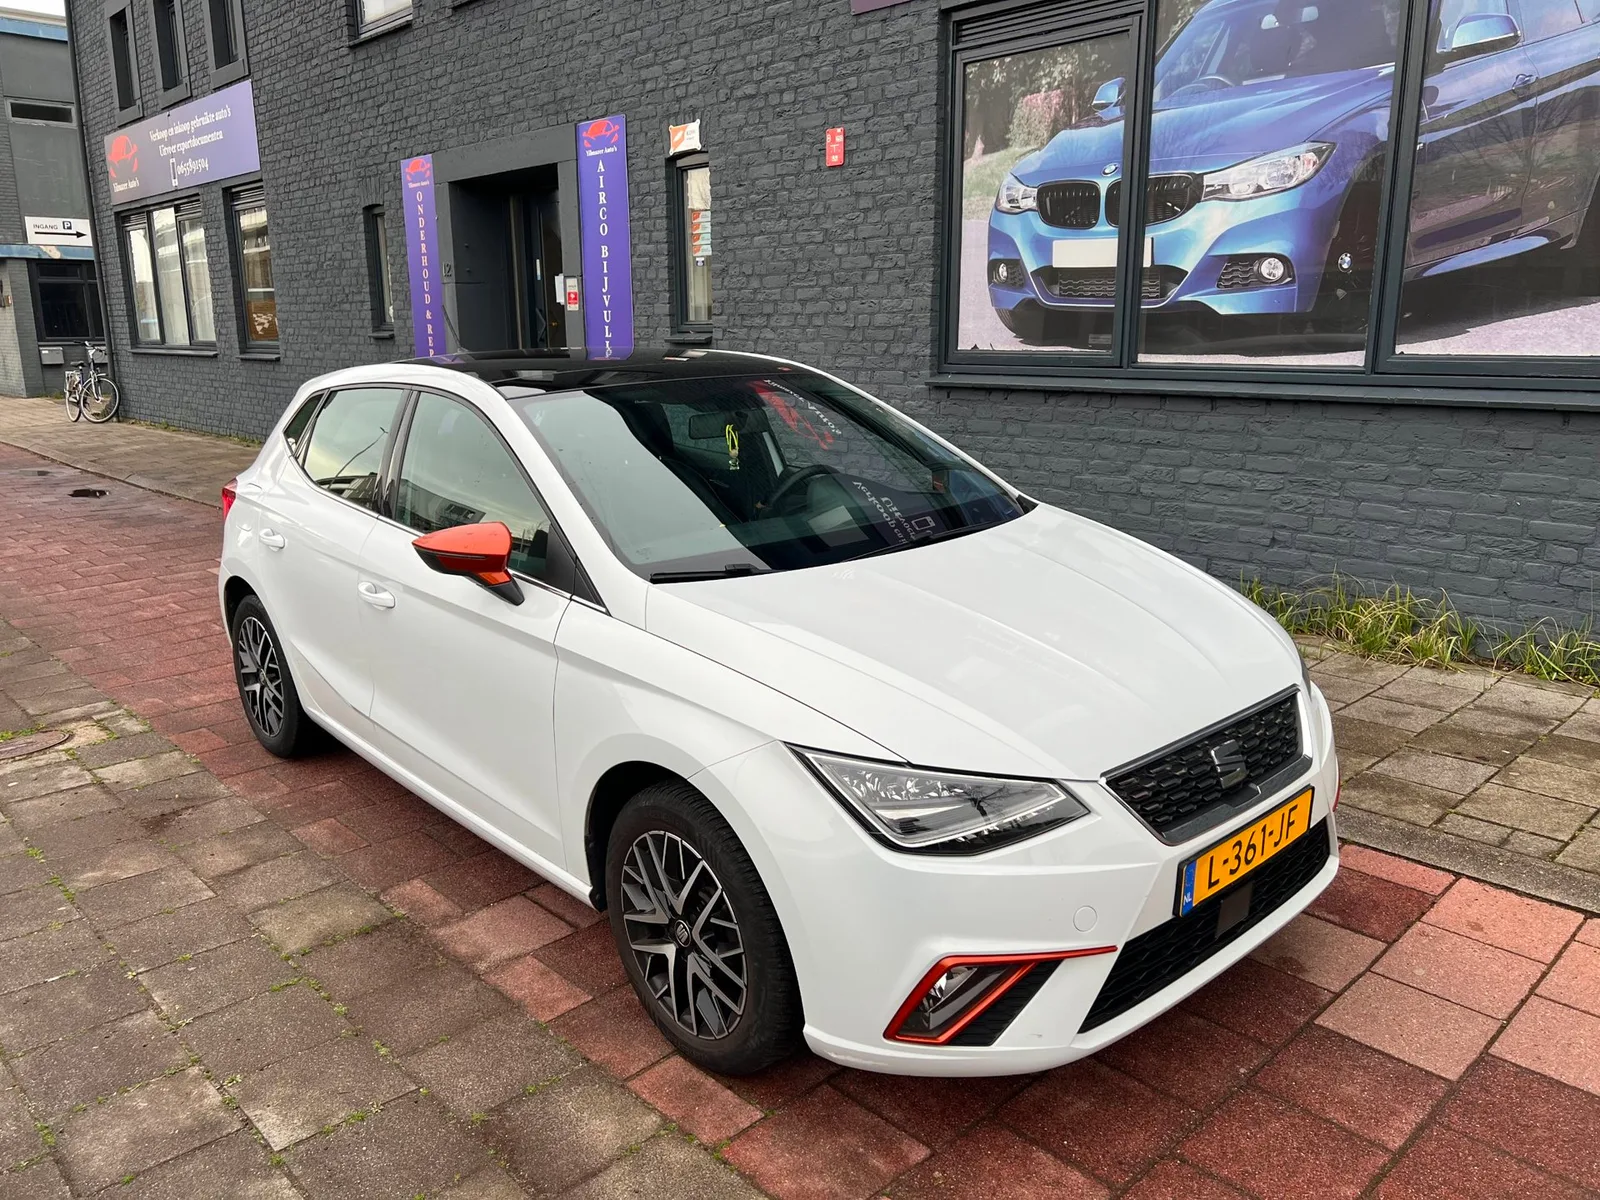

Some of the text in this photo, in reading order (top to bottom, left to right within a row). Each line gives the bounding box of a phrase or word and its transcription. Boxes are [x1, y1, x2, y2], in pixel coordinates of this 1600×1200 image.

[149, 104, 231, 141] Verkoop en inkoop gebruikte auto's
[159, 130, 223, 156] Uitvoer exportdocumenten
[597, 160, 608, 236] AIRCO
[63, 221, 71, 229] P
[416, 191, 431, 304] ONDERHOUD
[425, 309, 432, 320] &
[442, 262, 452, 277] 12
[1207, 804, 1298, 890] L-361-JF
[1183, 892, 1192, 906] NL
